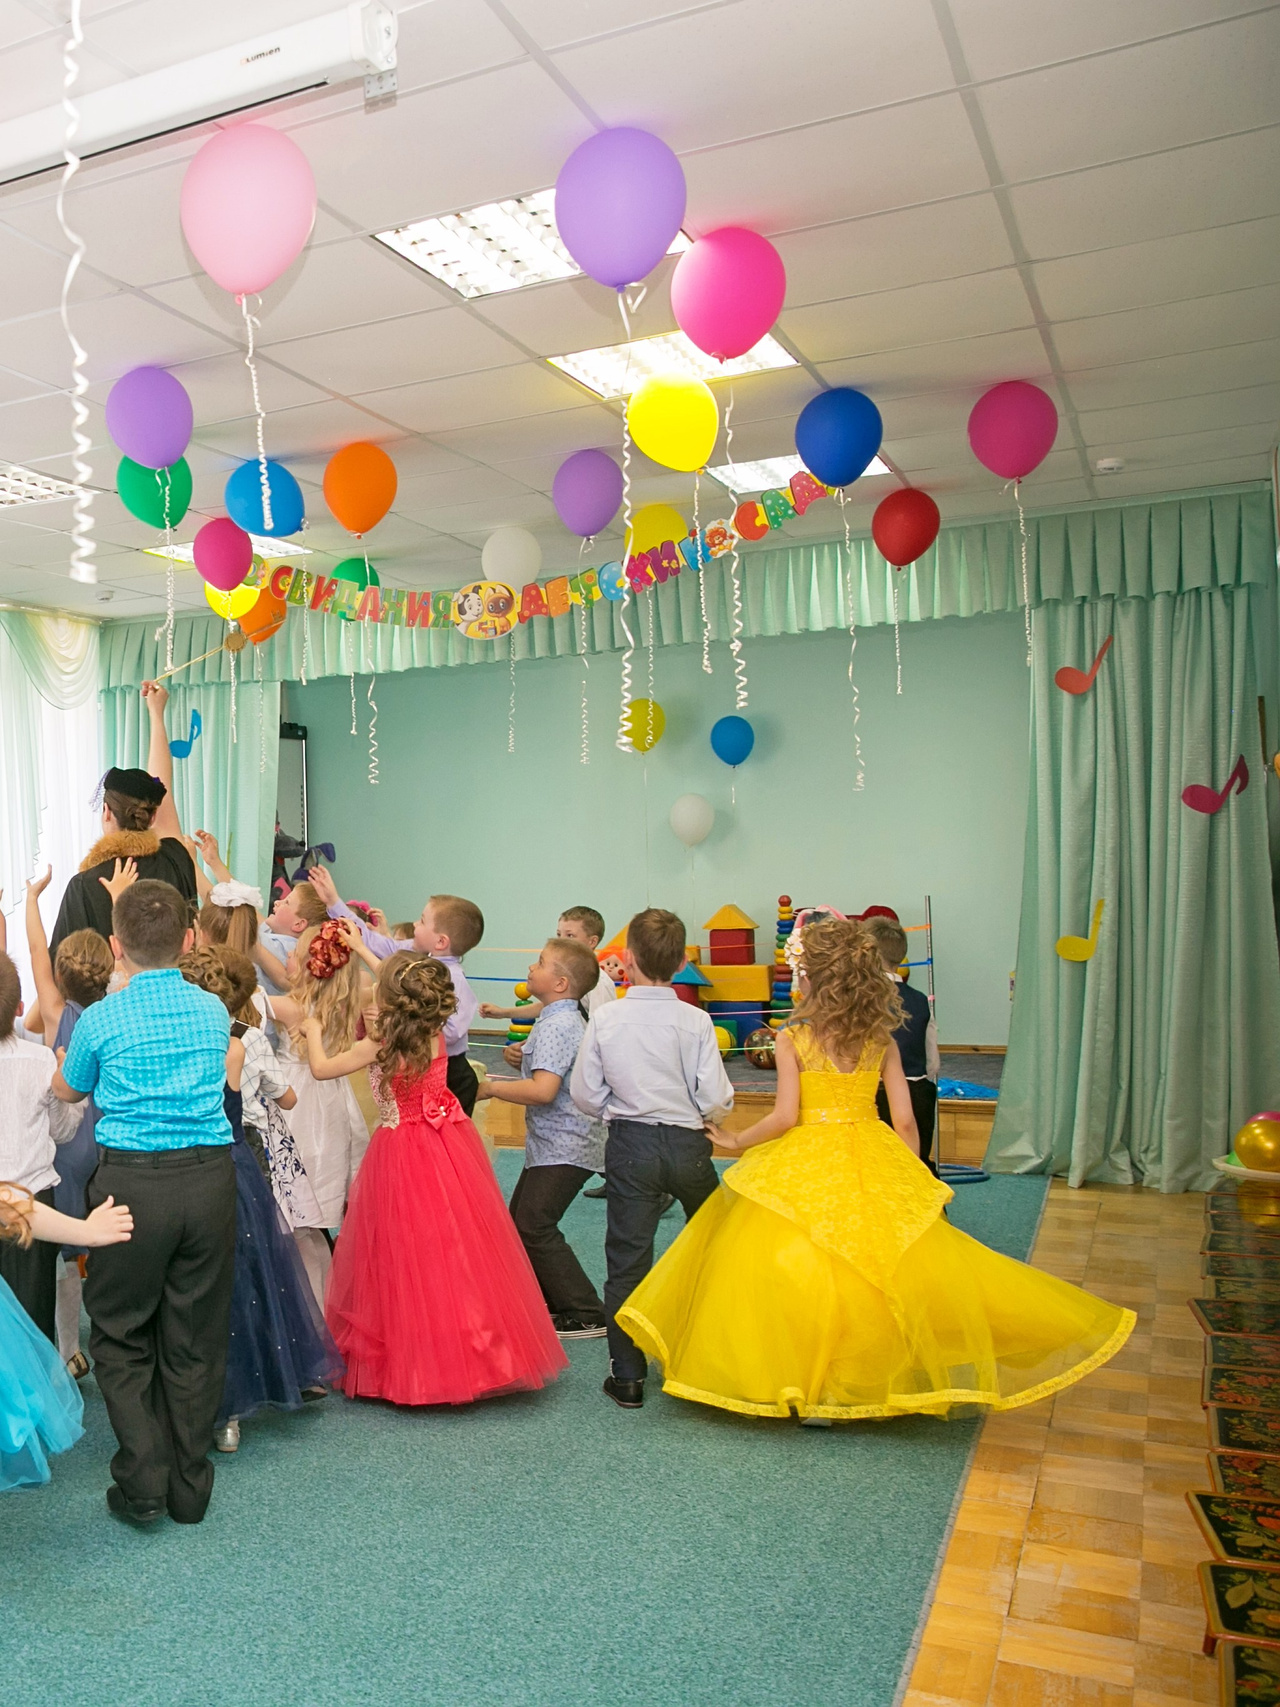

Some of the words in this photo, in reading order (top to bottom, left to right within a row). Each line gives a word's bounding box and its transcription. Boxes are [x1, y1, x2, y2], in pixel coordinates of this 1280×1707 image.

[270, 564, 455, 629] СВИДАНИЯ
[517, 518, 714, 624] ДЕТСКИЙ
[734, 470, 828, 541] САД
